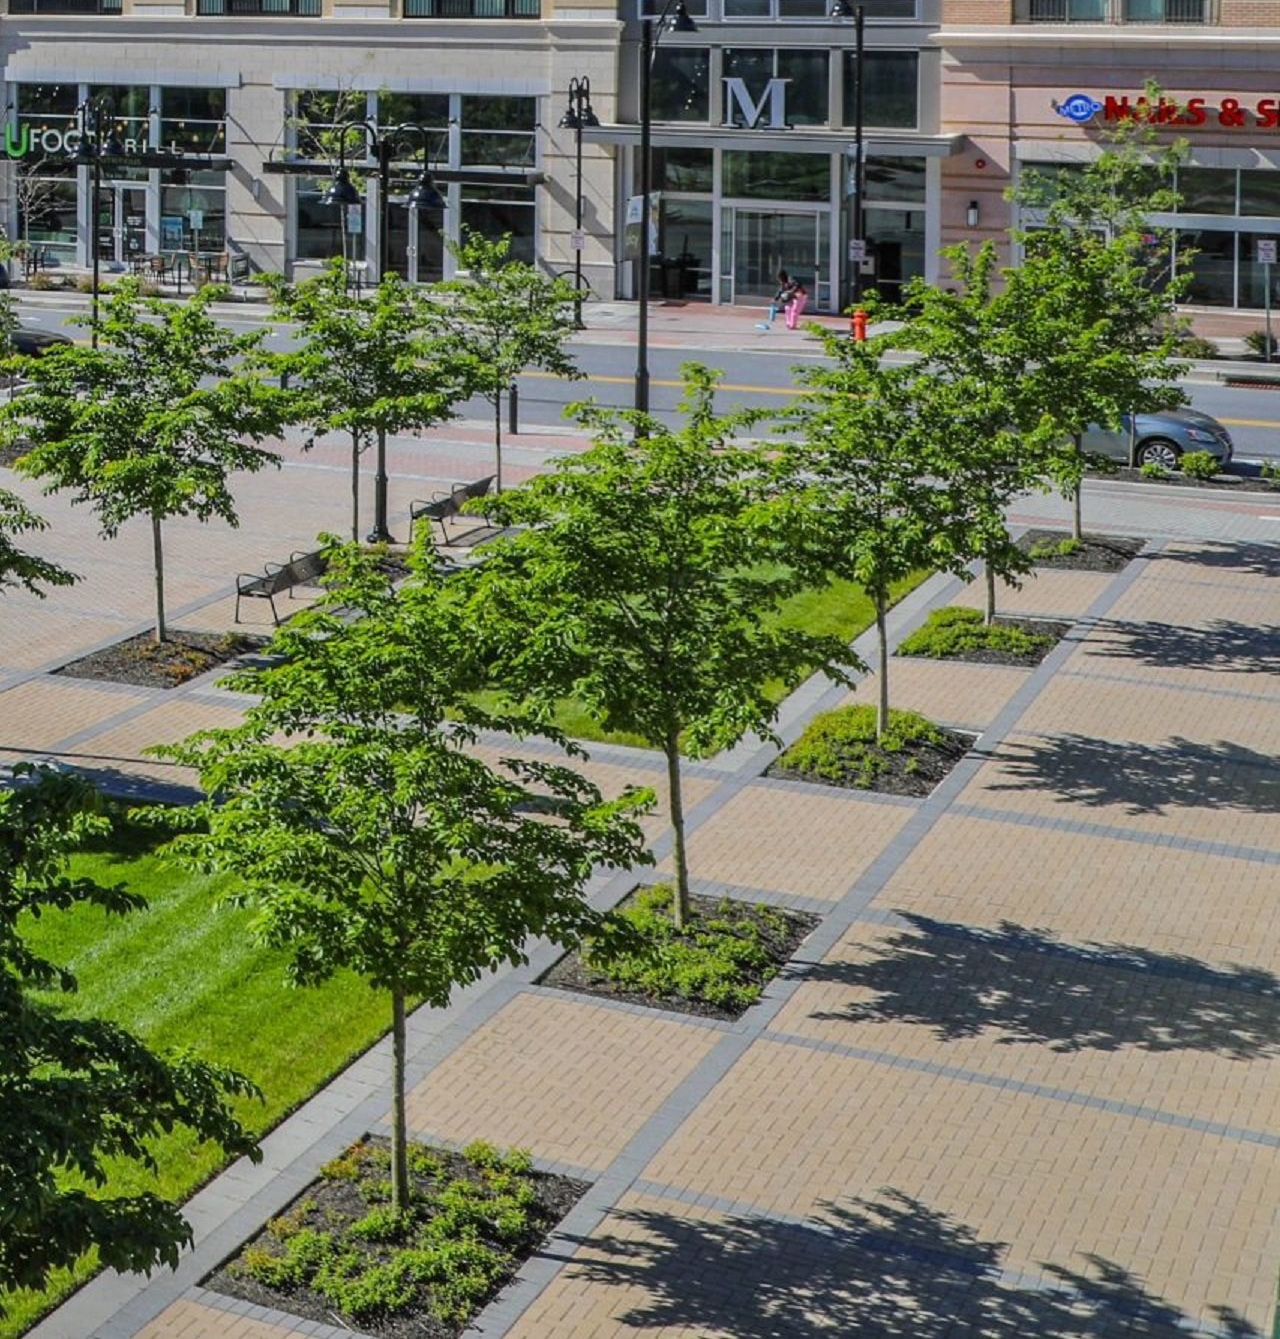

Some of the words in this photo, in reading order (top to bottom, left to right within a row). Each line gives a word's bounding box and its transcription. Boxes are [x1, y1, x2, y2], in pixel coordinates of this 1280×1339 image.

[721, 77, 793, 129] M
[1218, 99, 1248, 126] &
[1256, 99, 1280, 127] S
